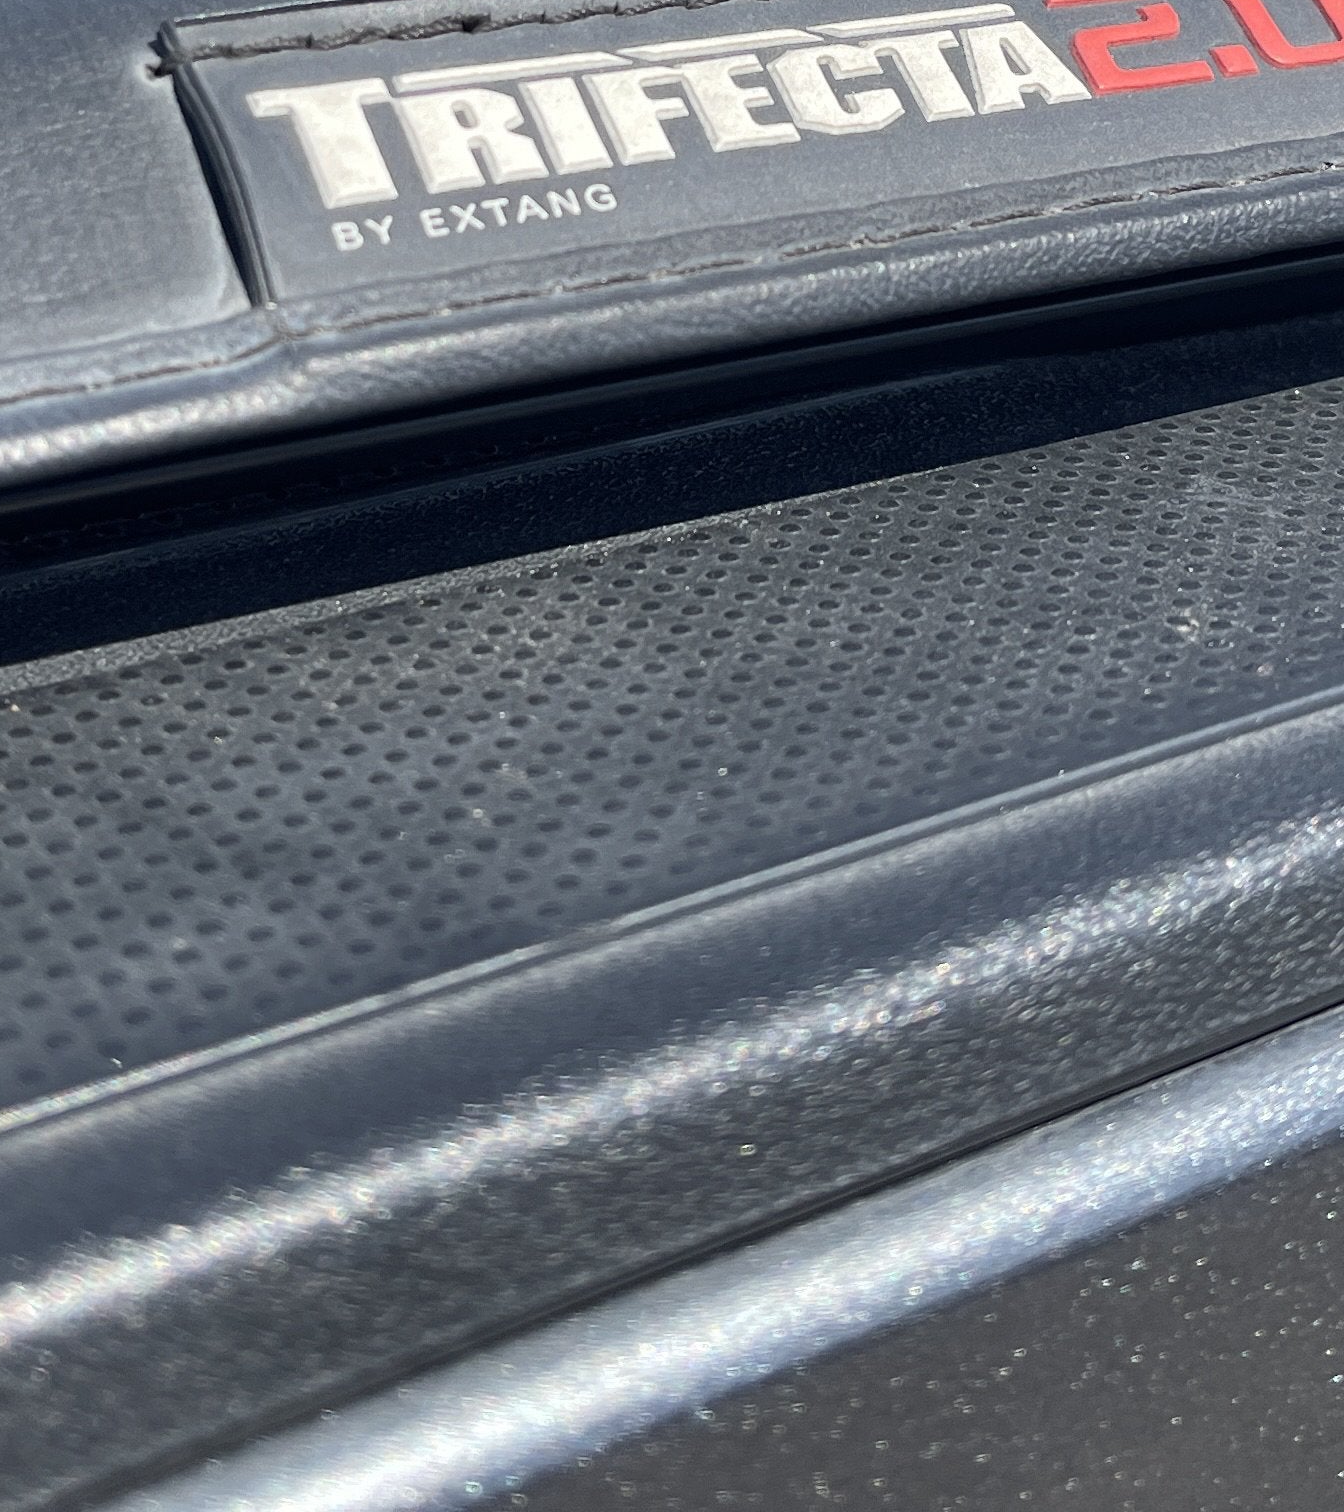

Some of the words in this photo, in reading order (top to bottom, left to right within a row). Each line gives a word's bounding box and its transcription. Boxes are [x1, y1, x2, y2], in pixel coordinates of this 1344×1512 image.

[244, 2, 1093, 210] TRIFECTA
[330, 214, 394, 252] BY
[419, 182, 618, 239] EXTANG
